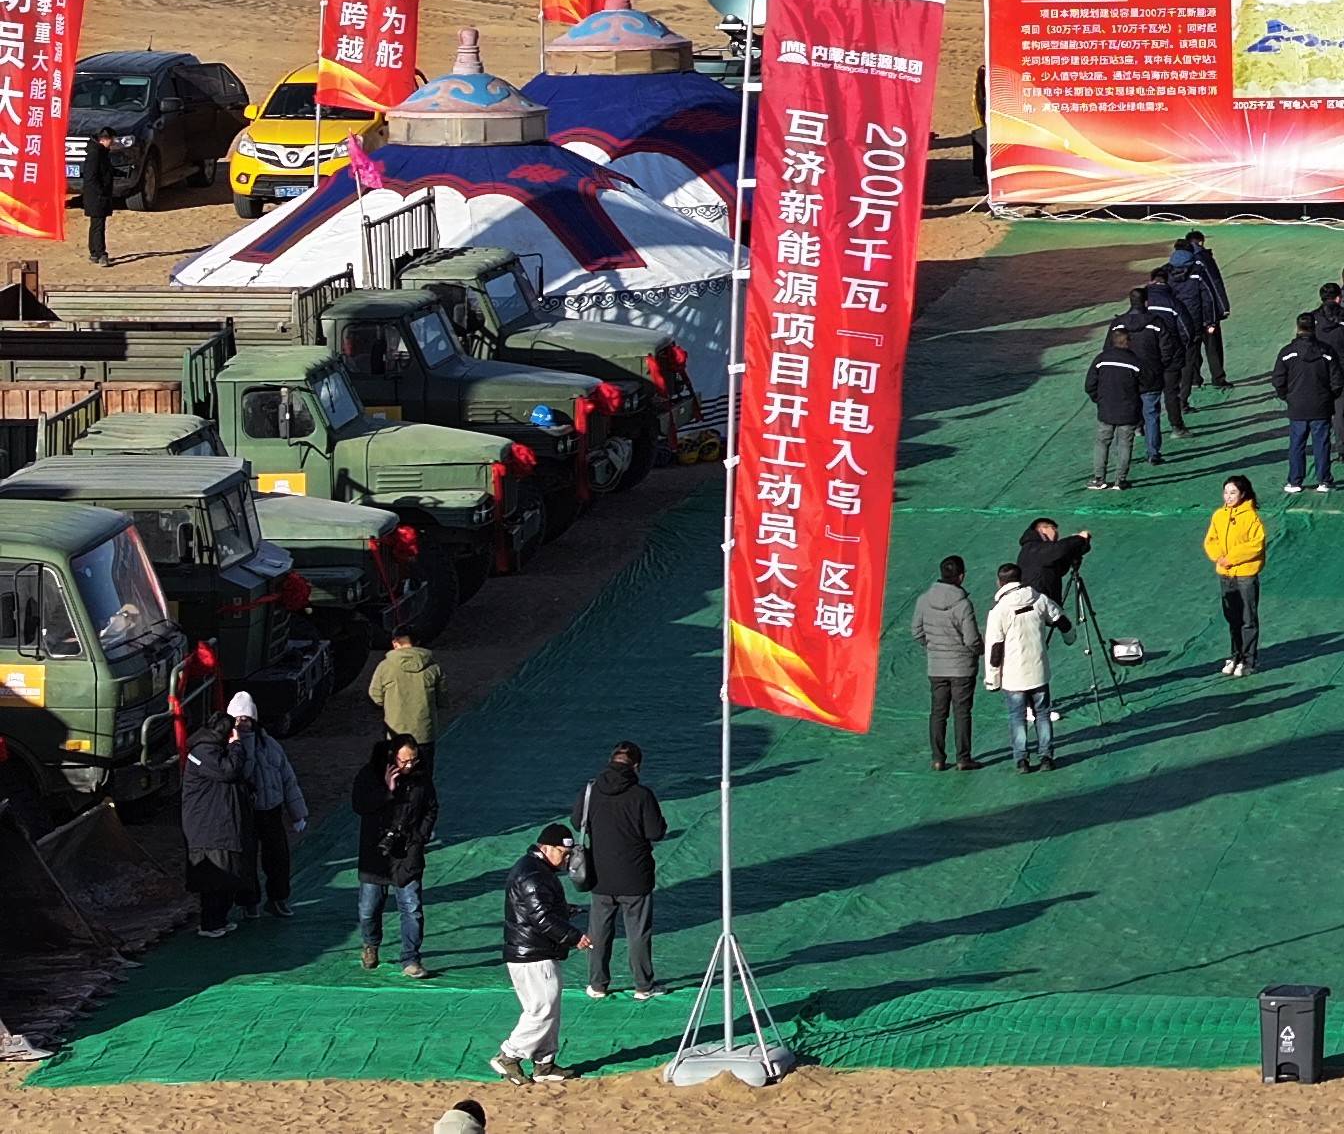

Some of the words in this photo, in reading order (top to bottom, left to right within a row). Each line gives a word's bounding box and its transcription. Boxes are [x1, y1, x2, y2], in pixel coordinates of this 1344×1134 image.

[810, 45, 924, 76] 内蒙古能源集团
[753, 108, 829, 629] 互济新能源项目开工动员大会
